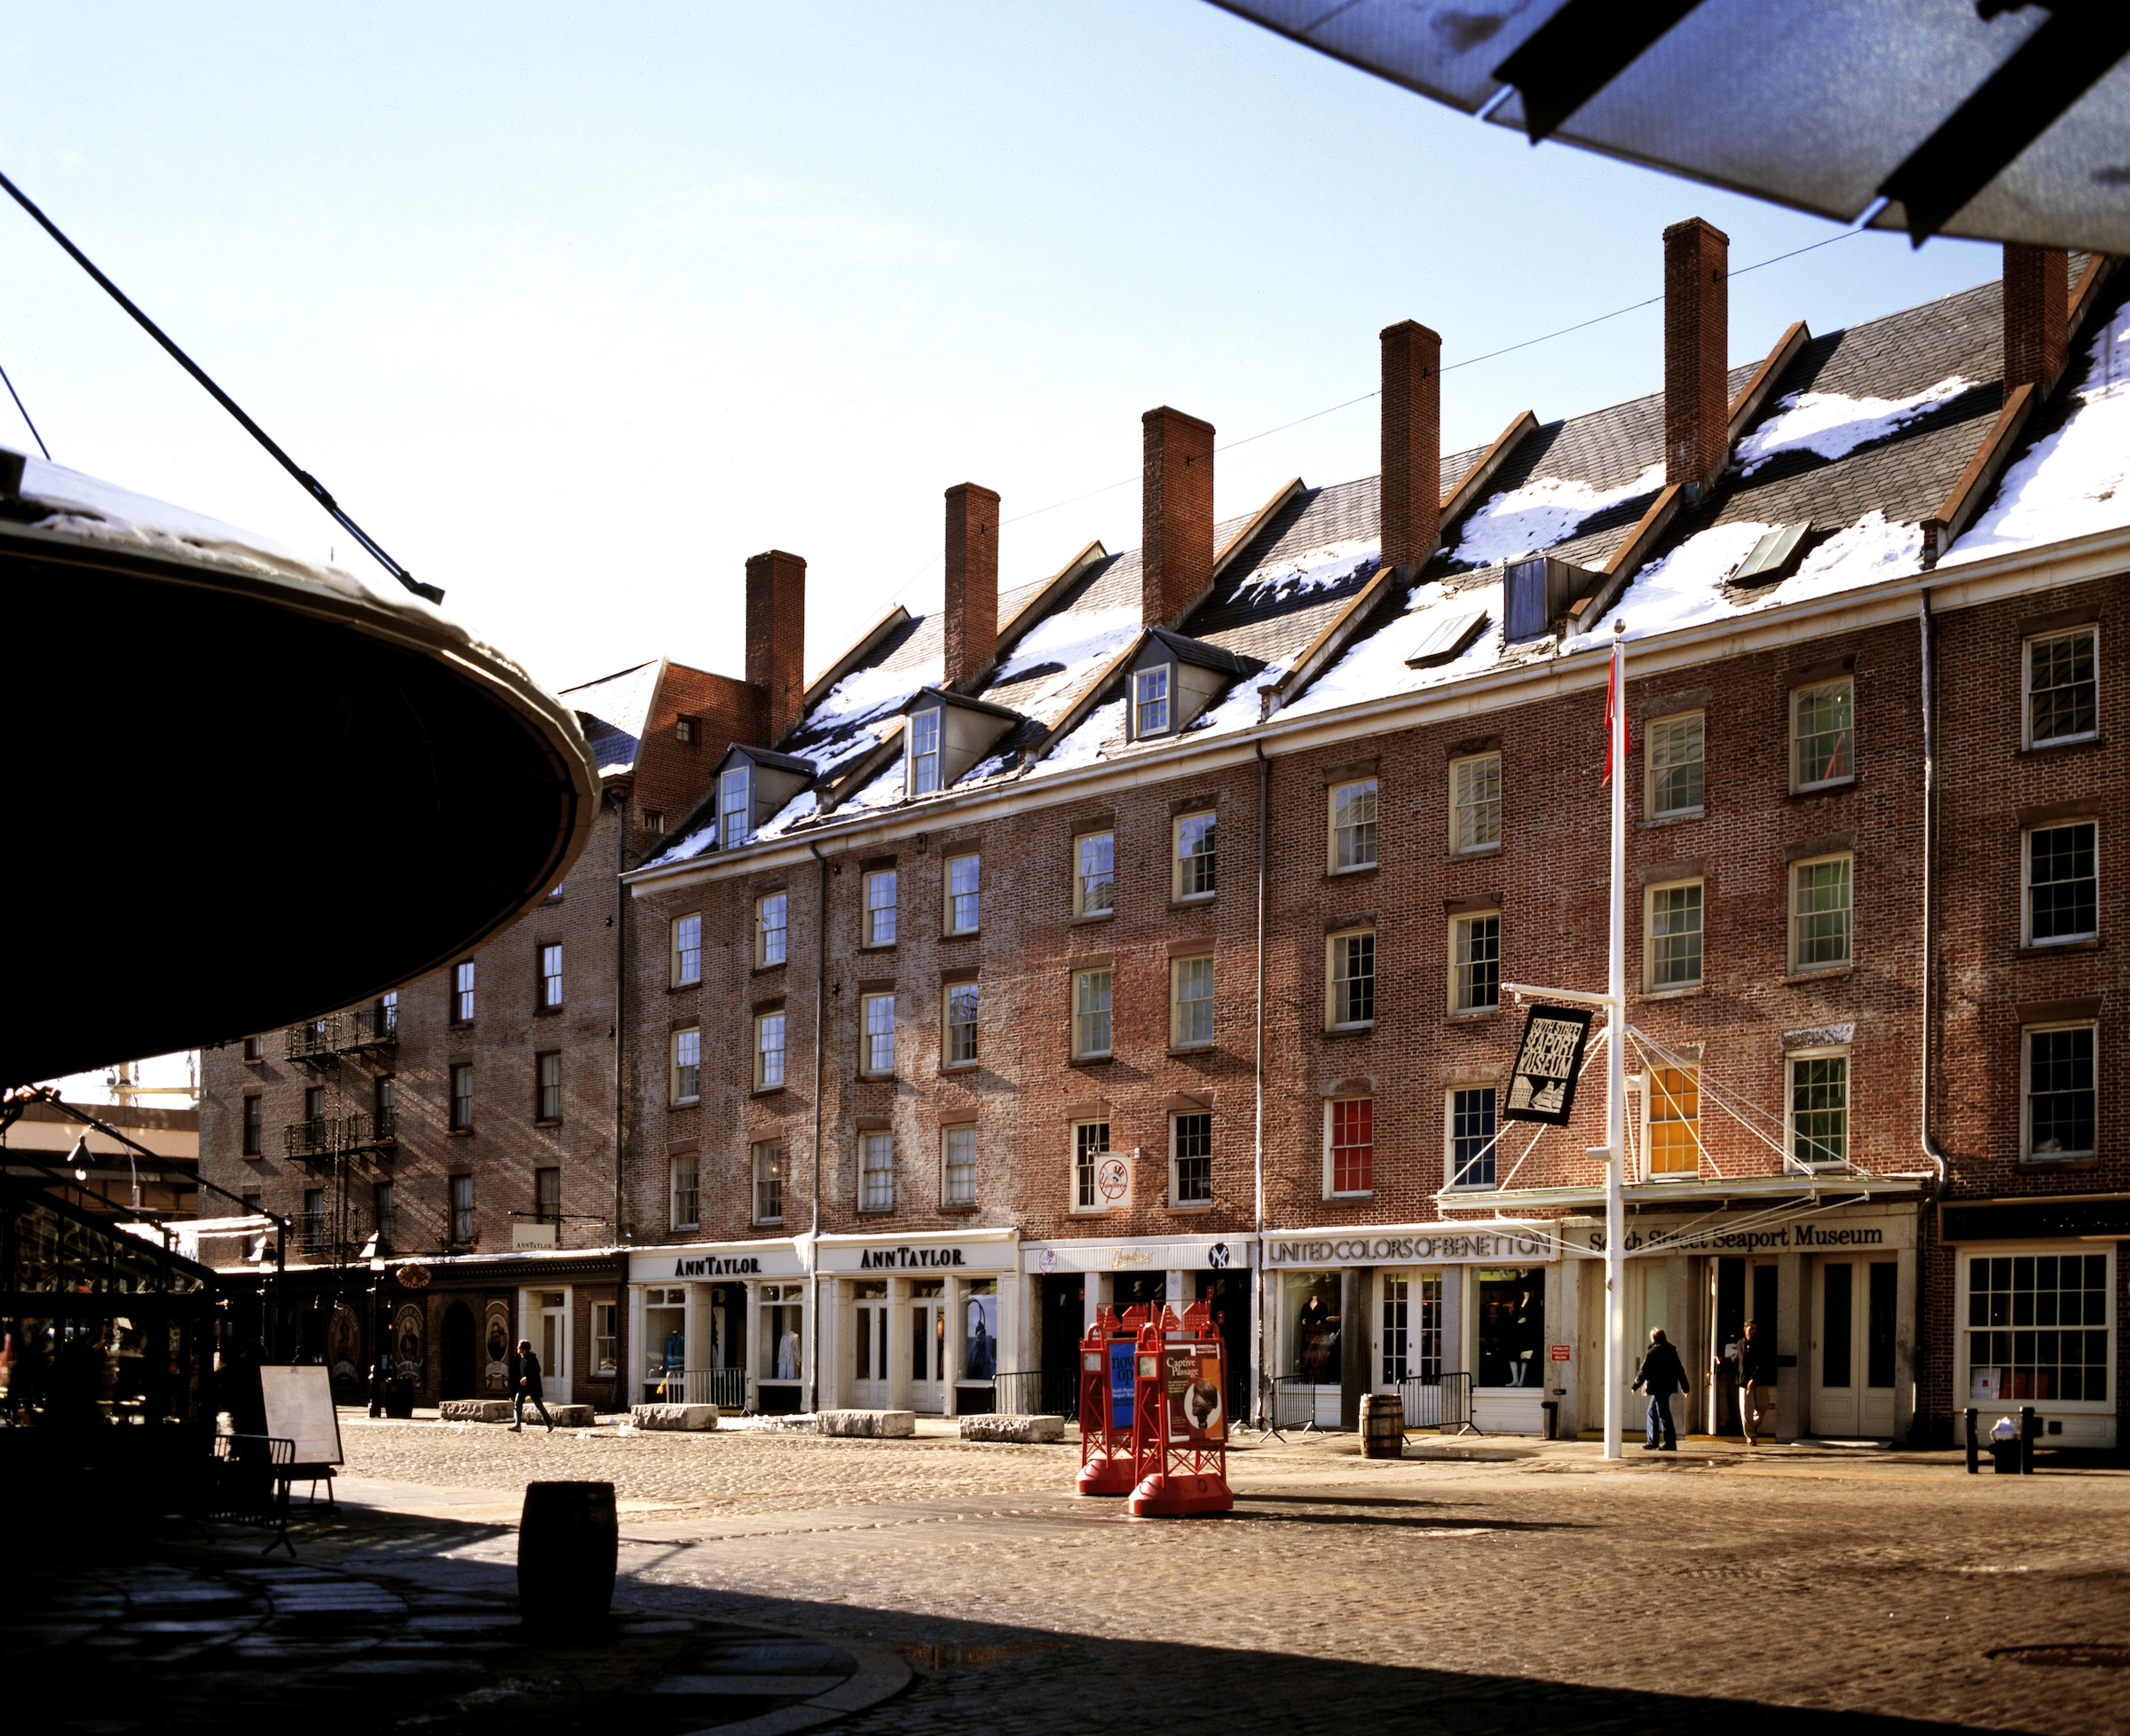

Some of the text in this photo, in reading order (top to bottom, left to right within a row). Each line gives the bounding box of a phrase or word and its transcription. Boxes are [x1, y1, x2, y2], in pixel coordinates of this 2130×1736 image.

[1531, 1018, 1583, 1038] SOUTH STREET
[1524, 1031, 1579, 1057] SEAPORT
[1516, 1051, 1574, 1079] MUSEUM
[1590, 1232, 1642, 1251] Sth
[1713, 1227, 1789, 1252] Seaport
[1795, 1225, 1883, 1246] Museum
[1166, 1357, 1196, 1370] Captive
[1172, 1367, 1199, 1377] Passage
[1117, 1369, 1134, 1385] op
